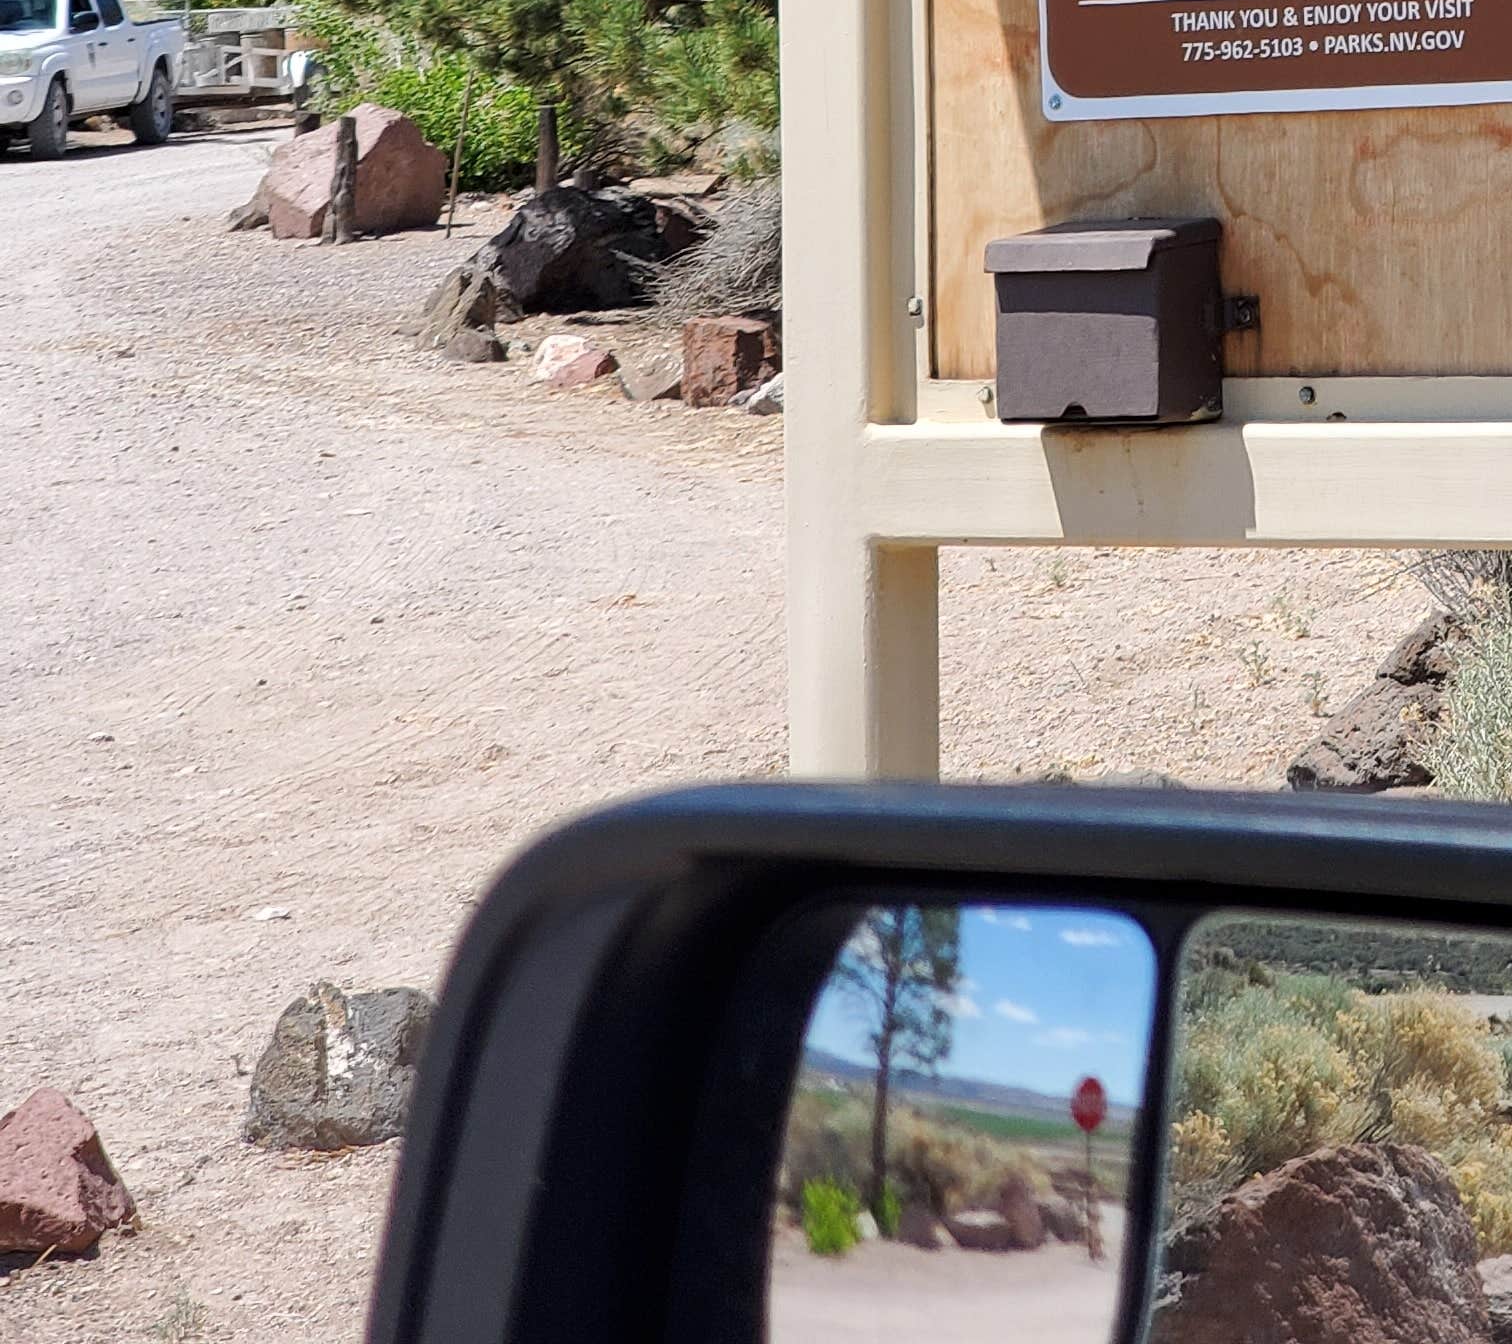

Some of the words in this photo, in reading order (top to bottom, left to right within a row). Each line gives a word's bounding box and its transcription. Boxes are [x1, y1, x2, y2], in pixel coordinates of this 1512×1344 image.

[1170, 9, 1235, 32] THANK
[1239, 7, 1278, 28] YOU
[1282, 6, 1299, 26] &
[1302, 2, 1362, 26] ENJOY
[1366, 0, 1421, 22] YOUR
[1181, 36, 1303, 61] 775-962-5103
[1324, 29, 1465, 54] PARKS.NV.GOV
